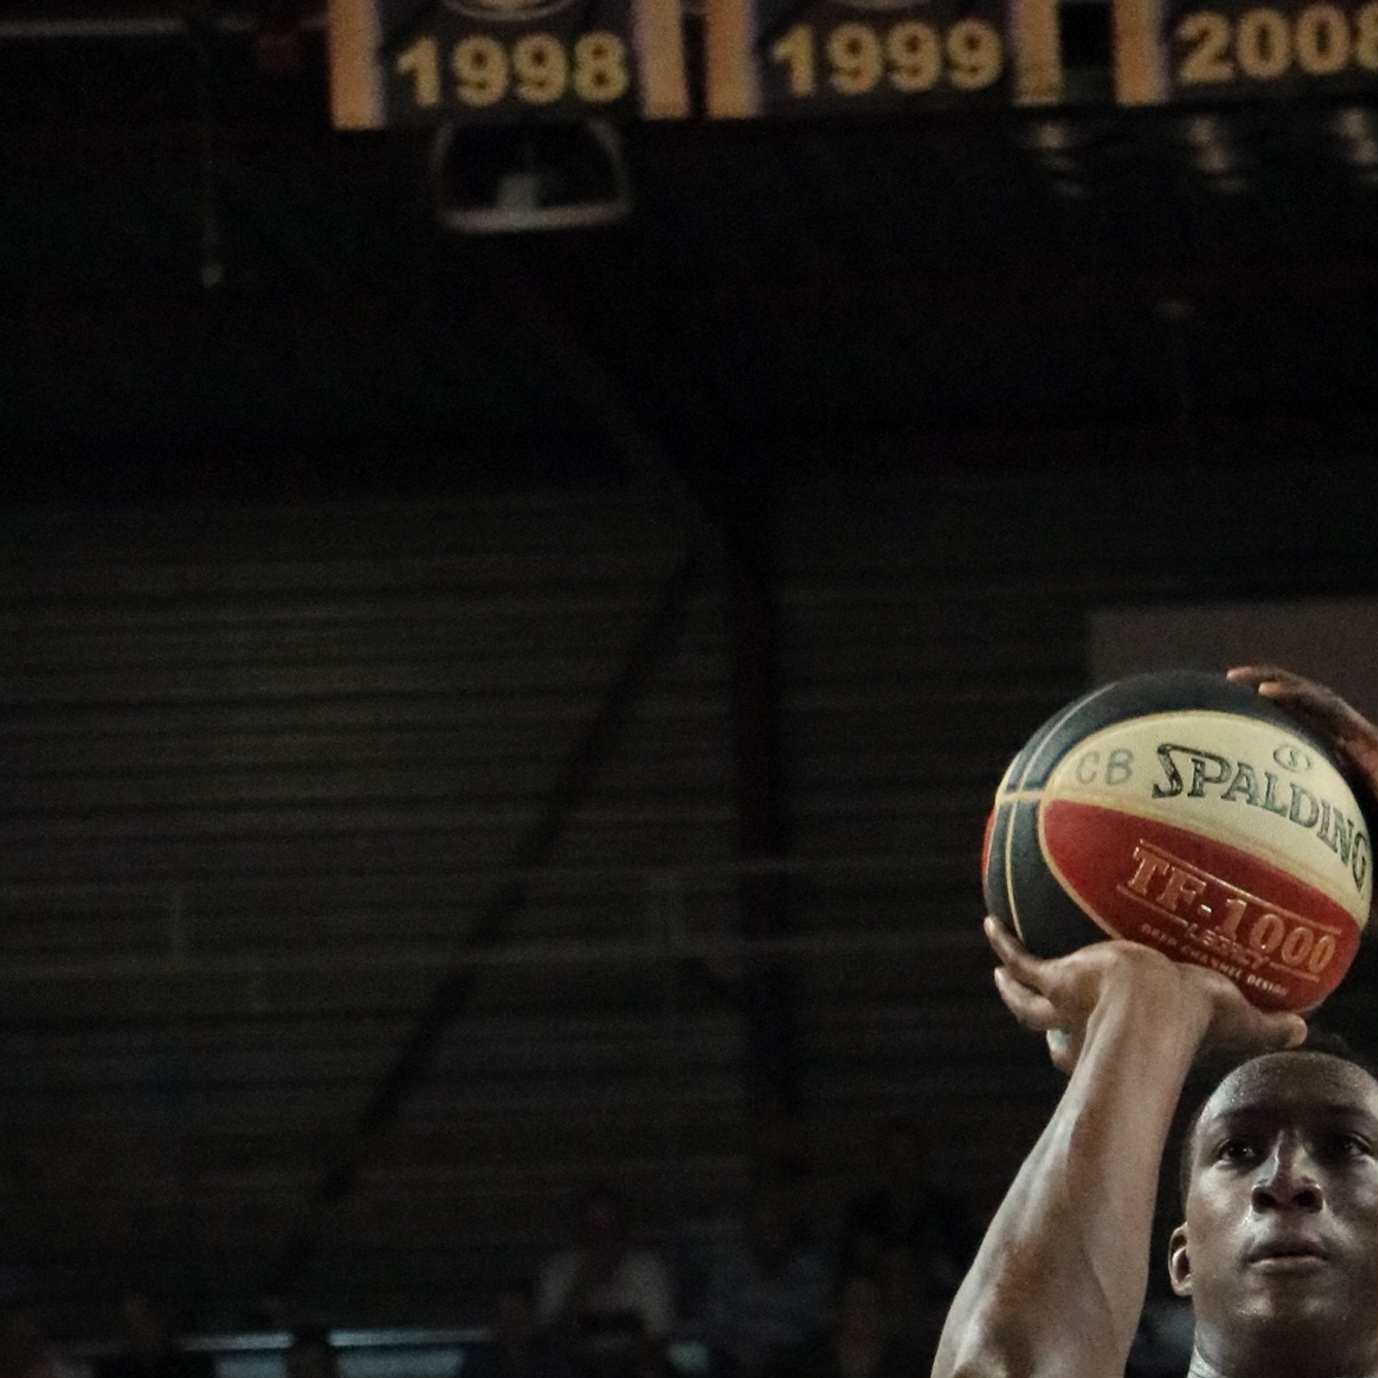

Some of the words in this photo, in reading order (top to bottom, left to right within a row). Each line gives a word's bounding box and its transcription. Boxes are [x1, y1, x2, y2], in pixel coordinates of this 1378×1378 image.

[399, 31, 628, 107] 1998
[770, 18, 1003, 96] 1999
[1075, 750, 1134, 785] CB
[1151, 742, 1371, 890] SPALDING
[1125, 845, 1340, 975] TF-1000
